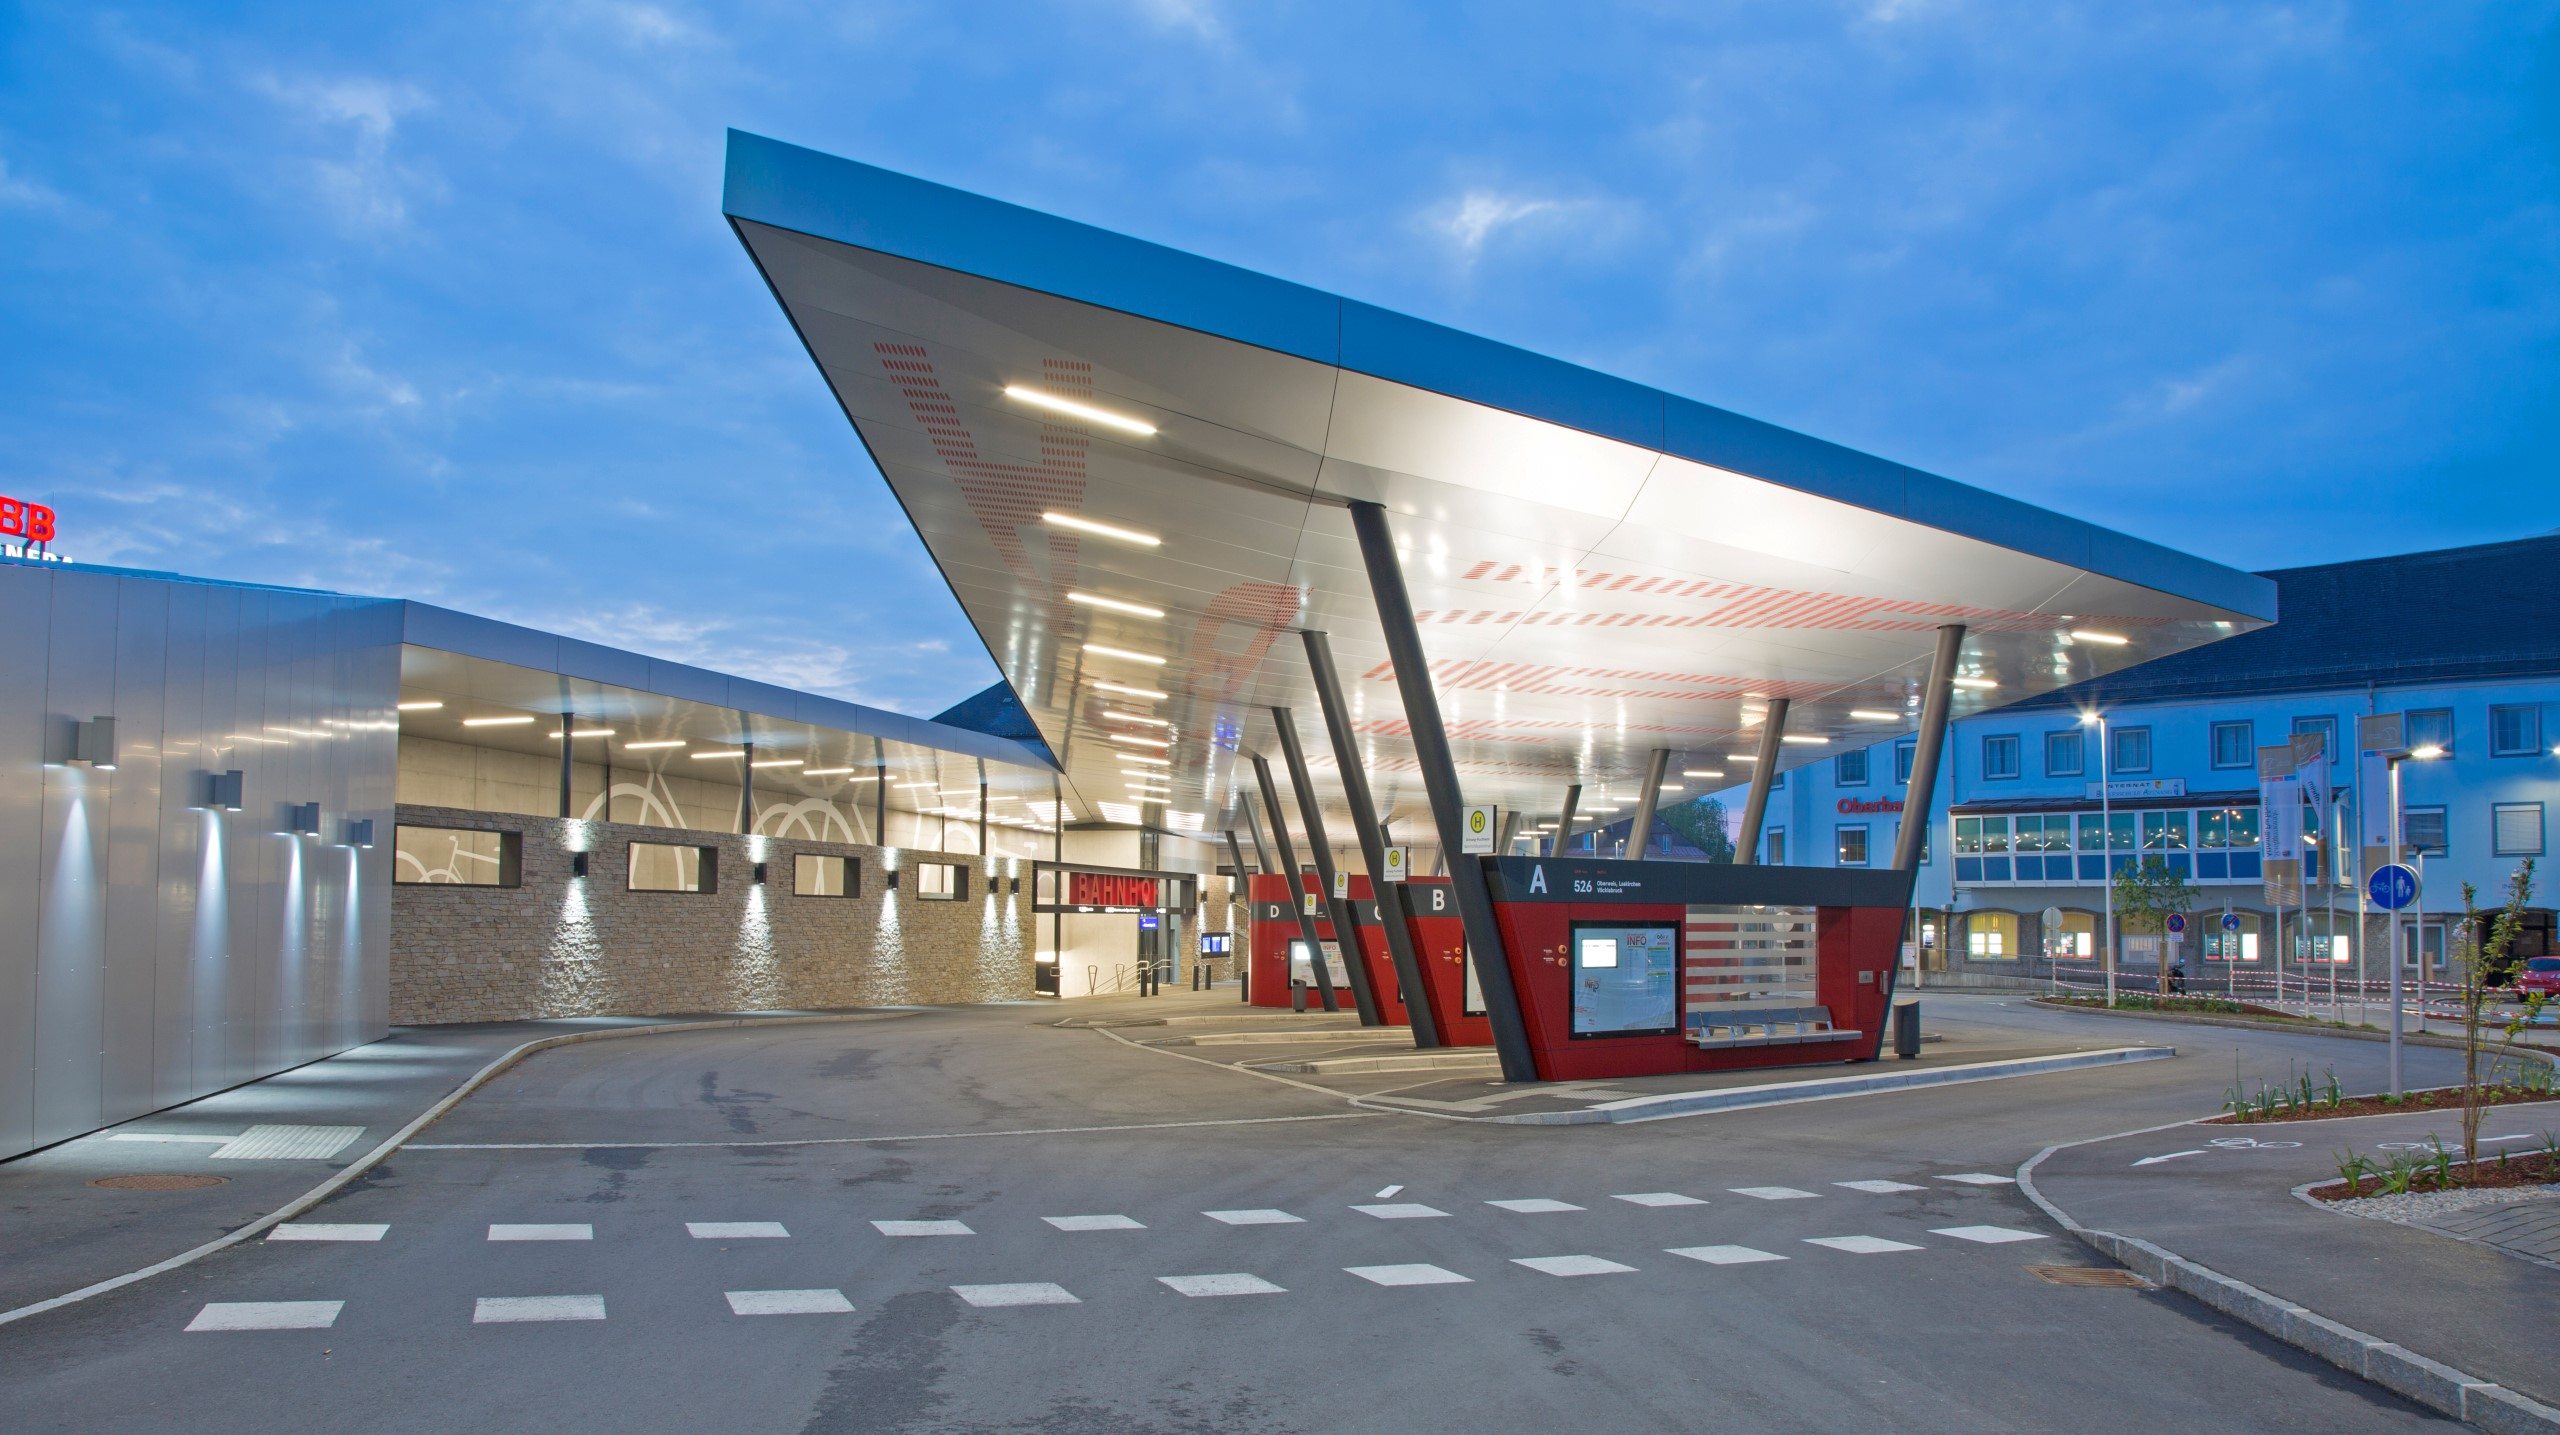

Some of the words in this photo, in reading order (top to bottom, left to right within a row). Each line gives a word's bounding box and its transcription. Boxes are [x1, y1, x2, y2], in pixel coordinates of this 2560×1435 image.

[1837, 795, 1905, 814] Oberba
[1529, 865, 1548, 893] A
[1574, 880, 1592, 893] 526
[1079, 872, 1160, 908] BAHNHOF
[1433, 889, 1445, 911] B
[1270, 904, 1280, 918] D
[1627, 934, 1647, 946] INFO
